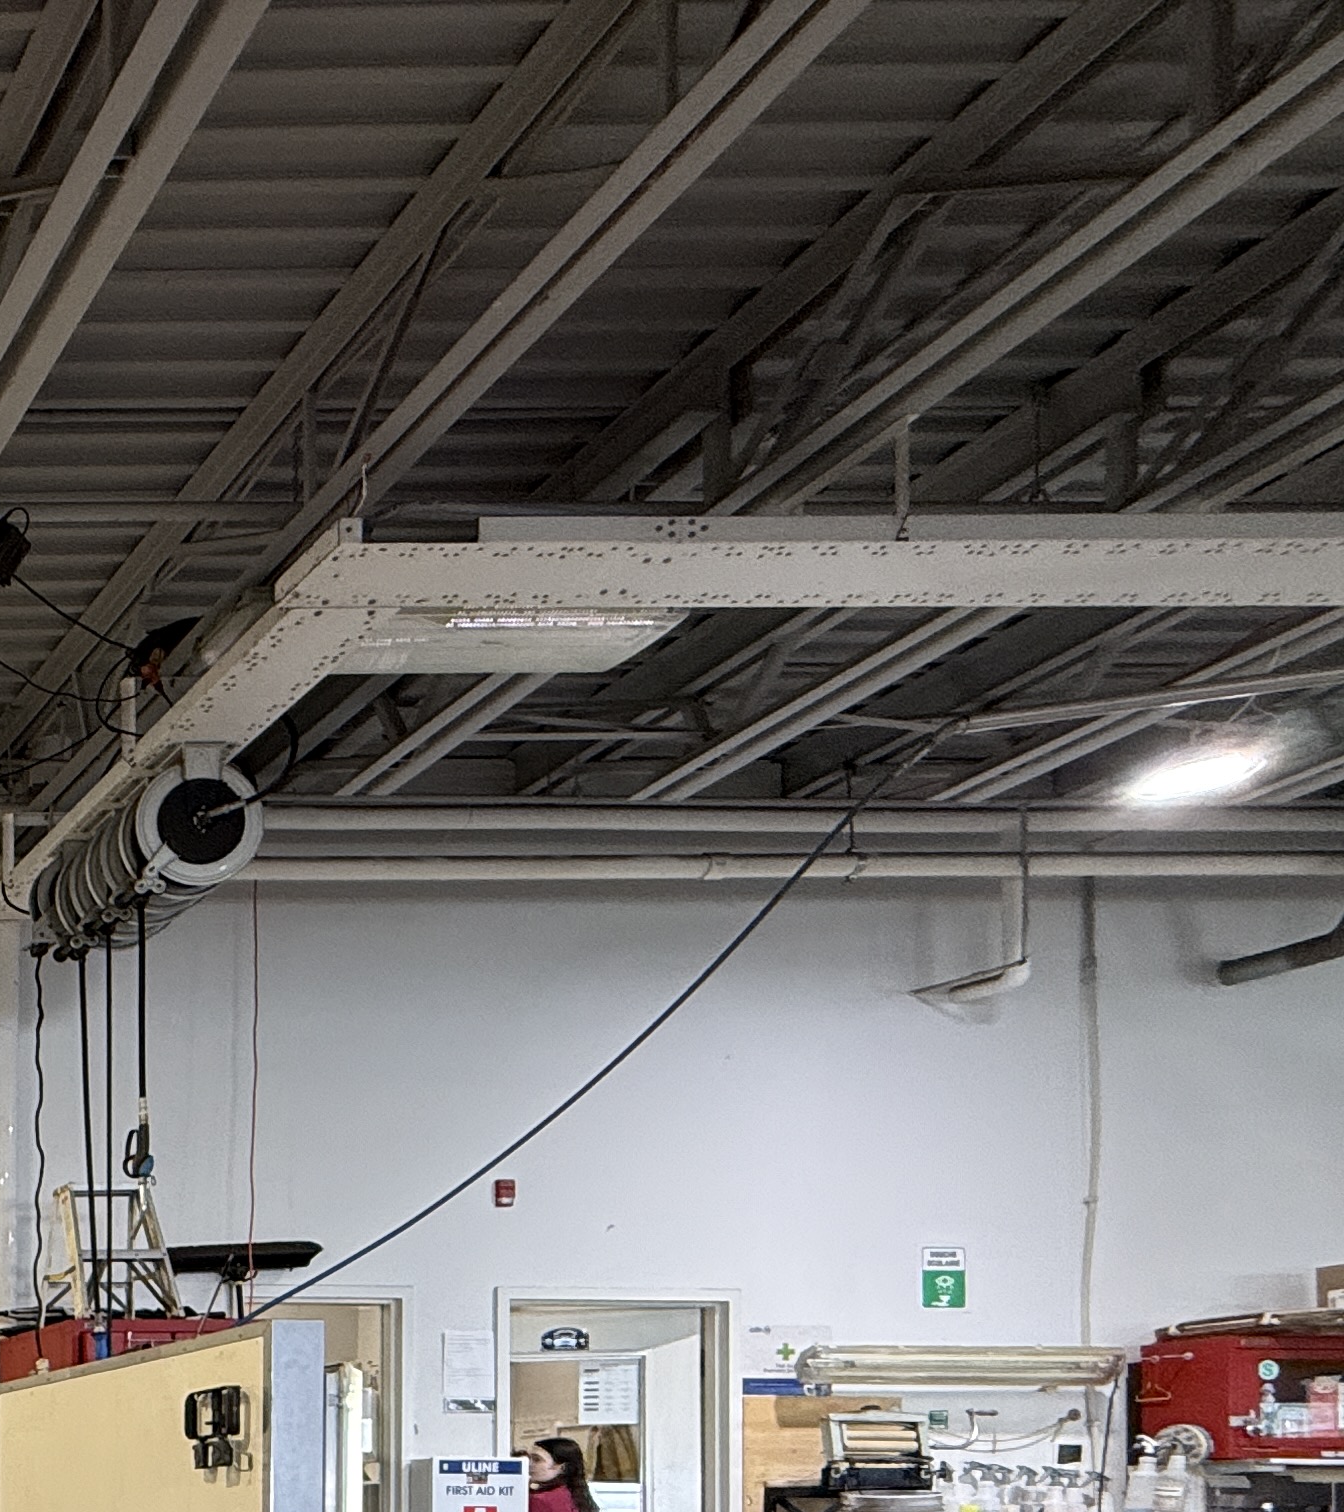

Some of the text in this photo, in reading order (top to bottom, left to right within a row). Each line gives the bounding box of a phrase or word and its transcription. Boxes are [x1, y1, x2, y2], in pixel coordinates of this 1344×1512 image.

[461, 1461, 500, 1473] ULINE
[445, 1485, 515, 1496] FIRST AID KIT
